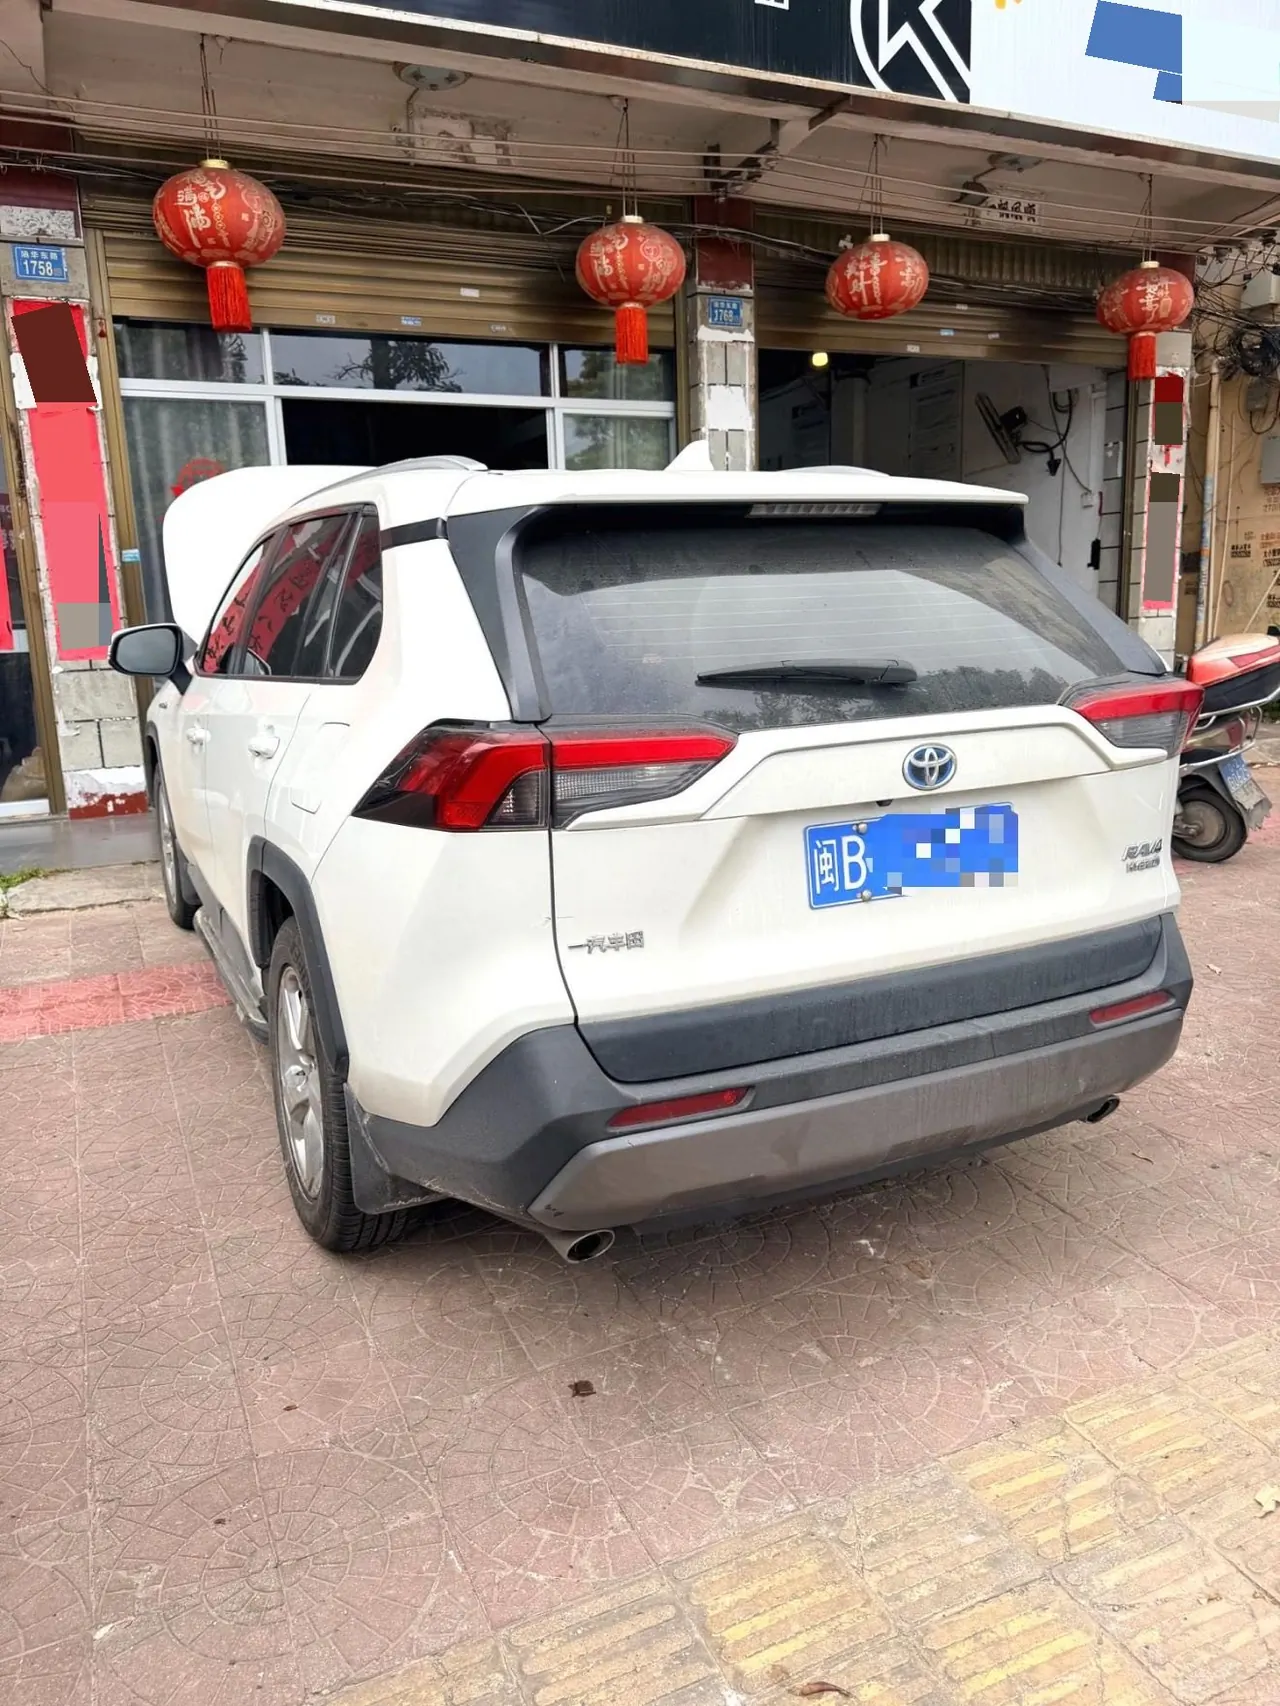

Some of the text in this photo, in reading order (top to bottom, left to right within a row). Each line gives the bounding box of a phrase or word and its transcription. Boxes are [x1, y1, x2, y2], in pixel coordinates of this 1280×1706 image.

[23, 260, 53, 277] 1758
[1121, 838, 1163, 862] RAV4
[813, 834, 868, 895] 闽B
